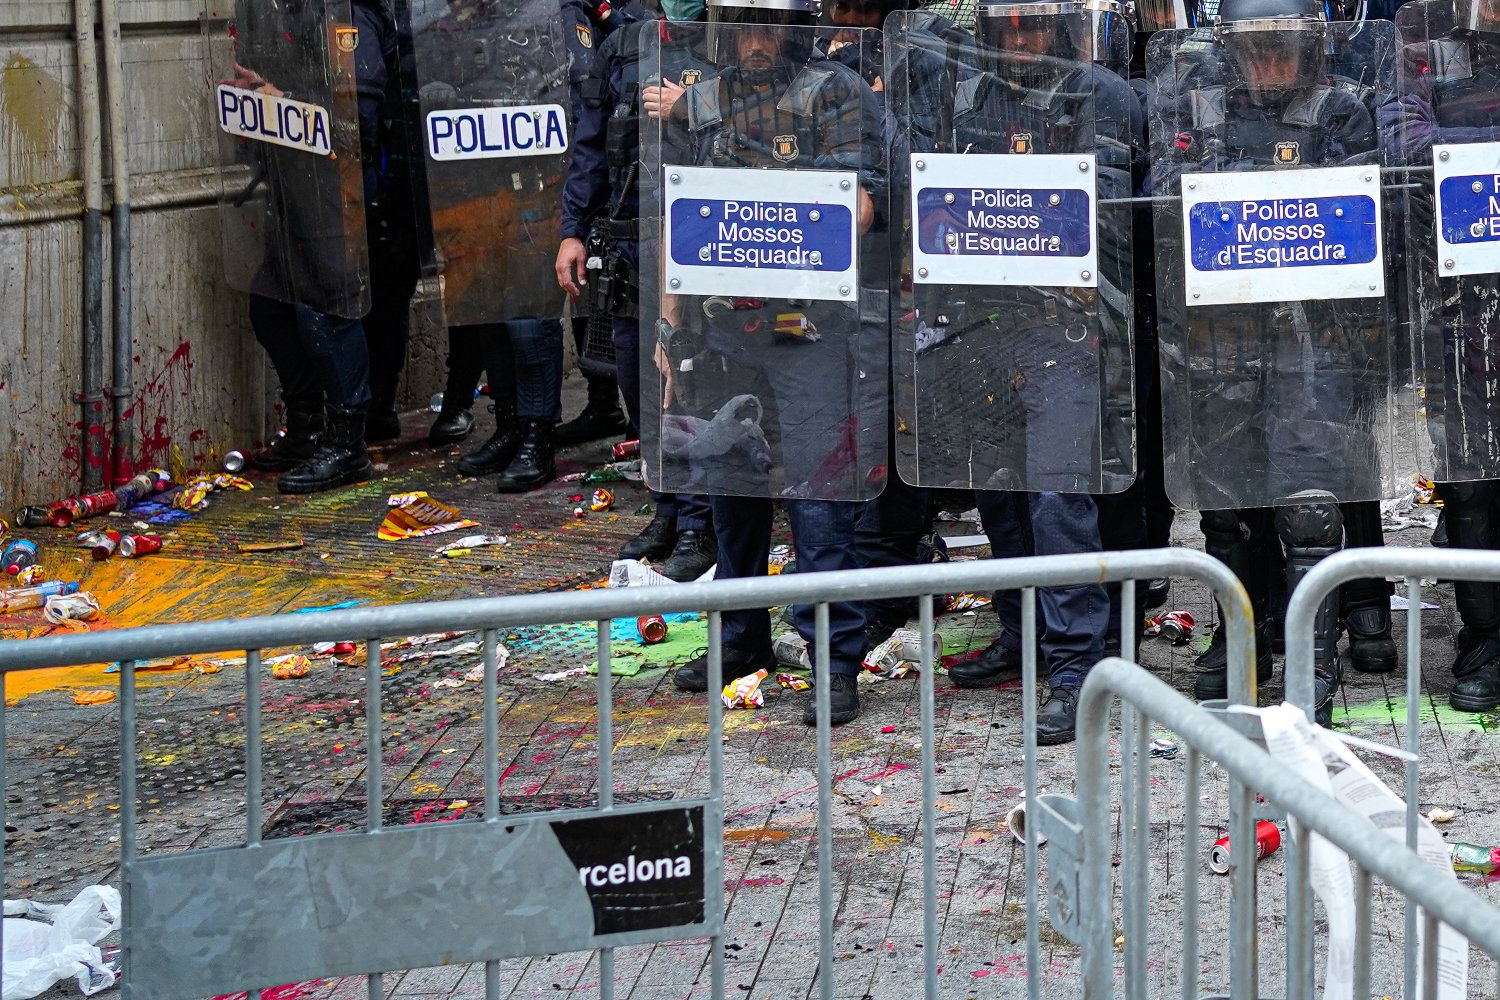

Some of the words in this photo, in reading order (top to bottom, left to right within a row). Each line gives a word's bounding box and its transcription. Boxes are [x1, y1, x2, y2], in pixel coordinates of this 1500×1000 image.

[220, 89, 329, 150] POLICIA
[430, 110, 566, 154] POLICIA
[971, 190, 1033, 208] Policia
[724, 201, 797, 222] Policia
[967, 211, 1039, 229] Mossos
[1242, 200, 1319, 220] Policia
[718, 222, 803, 243] Mossos
[1237, 223, 1325, 242] Mossos
